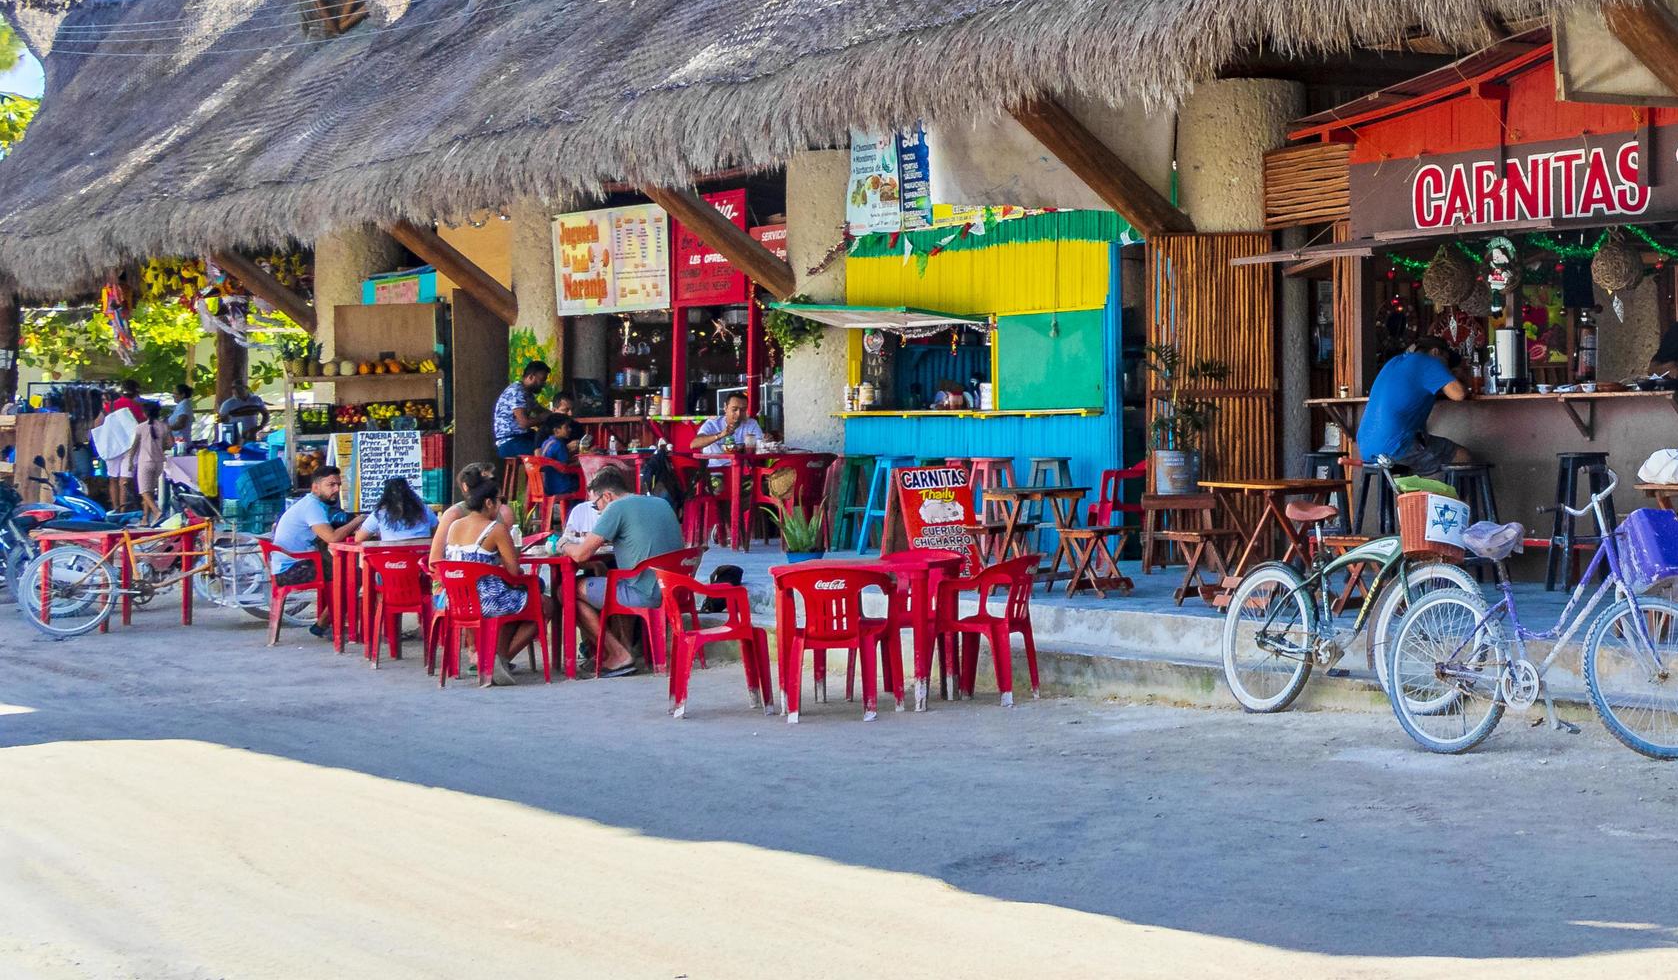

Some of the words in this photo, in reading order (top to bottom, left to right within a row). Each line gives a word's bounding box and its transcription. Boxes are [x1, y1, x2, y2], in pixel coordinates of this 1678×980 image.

[1412, 140, 1651, 229] CARNITAS
[563, 271, 608, 306] Naranja
[901, 469, 968, 489] CARNITAS
[914, 535, 971, 548] CHICHARRO
